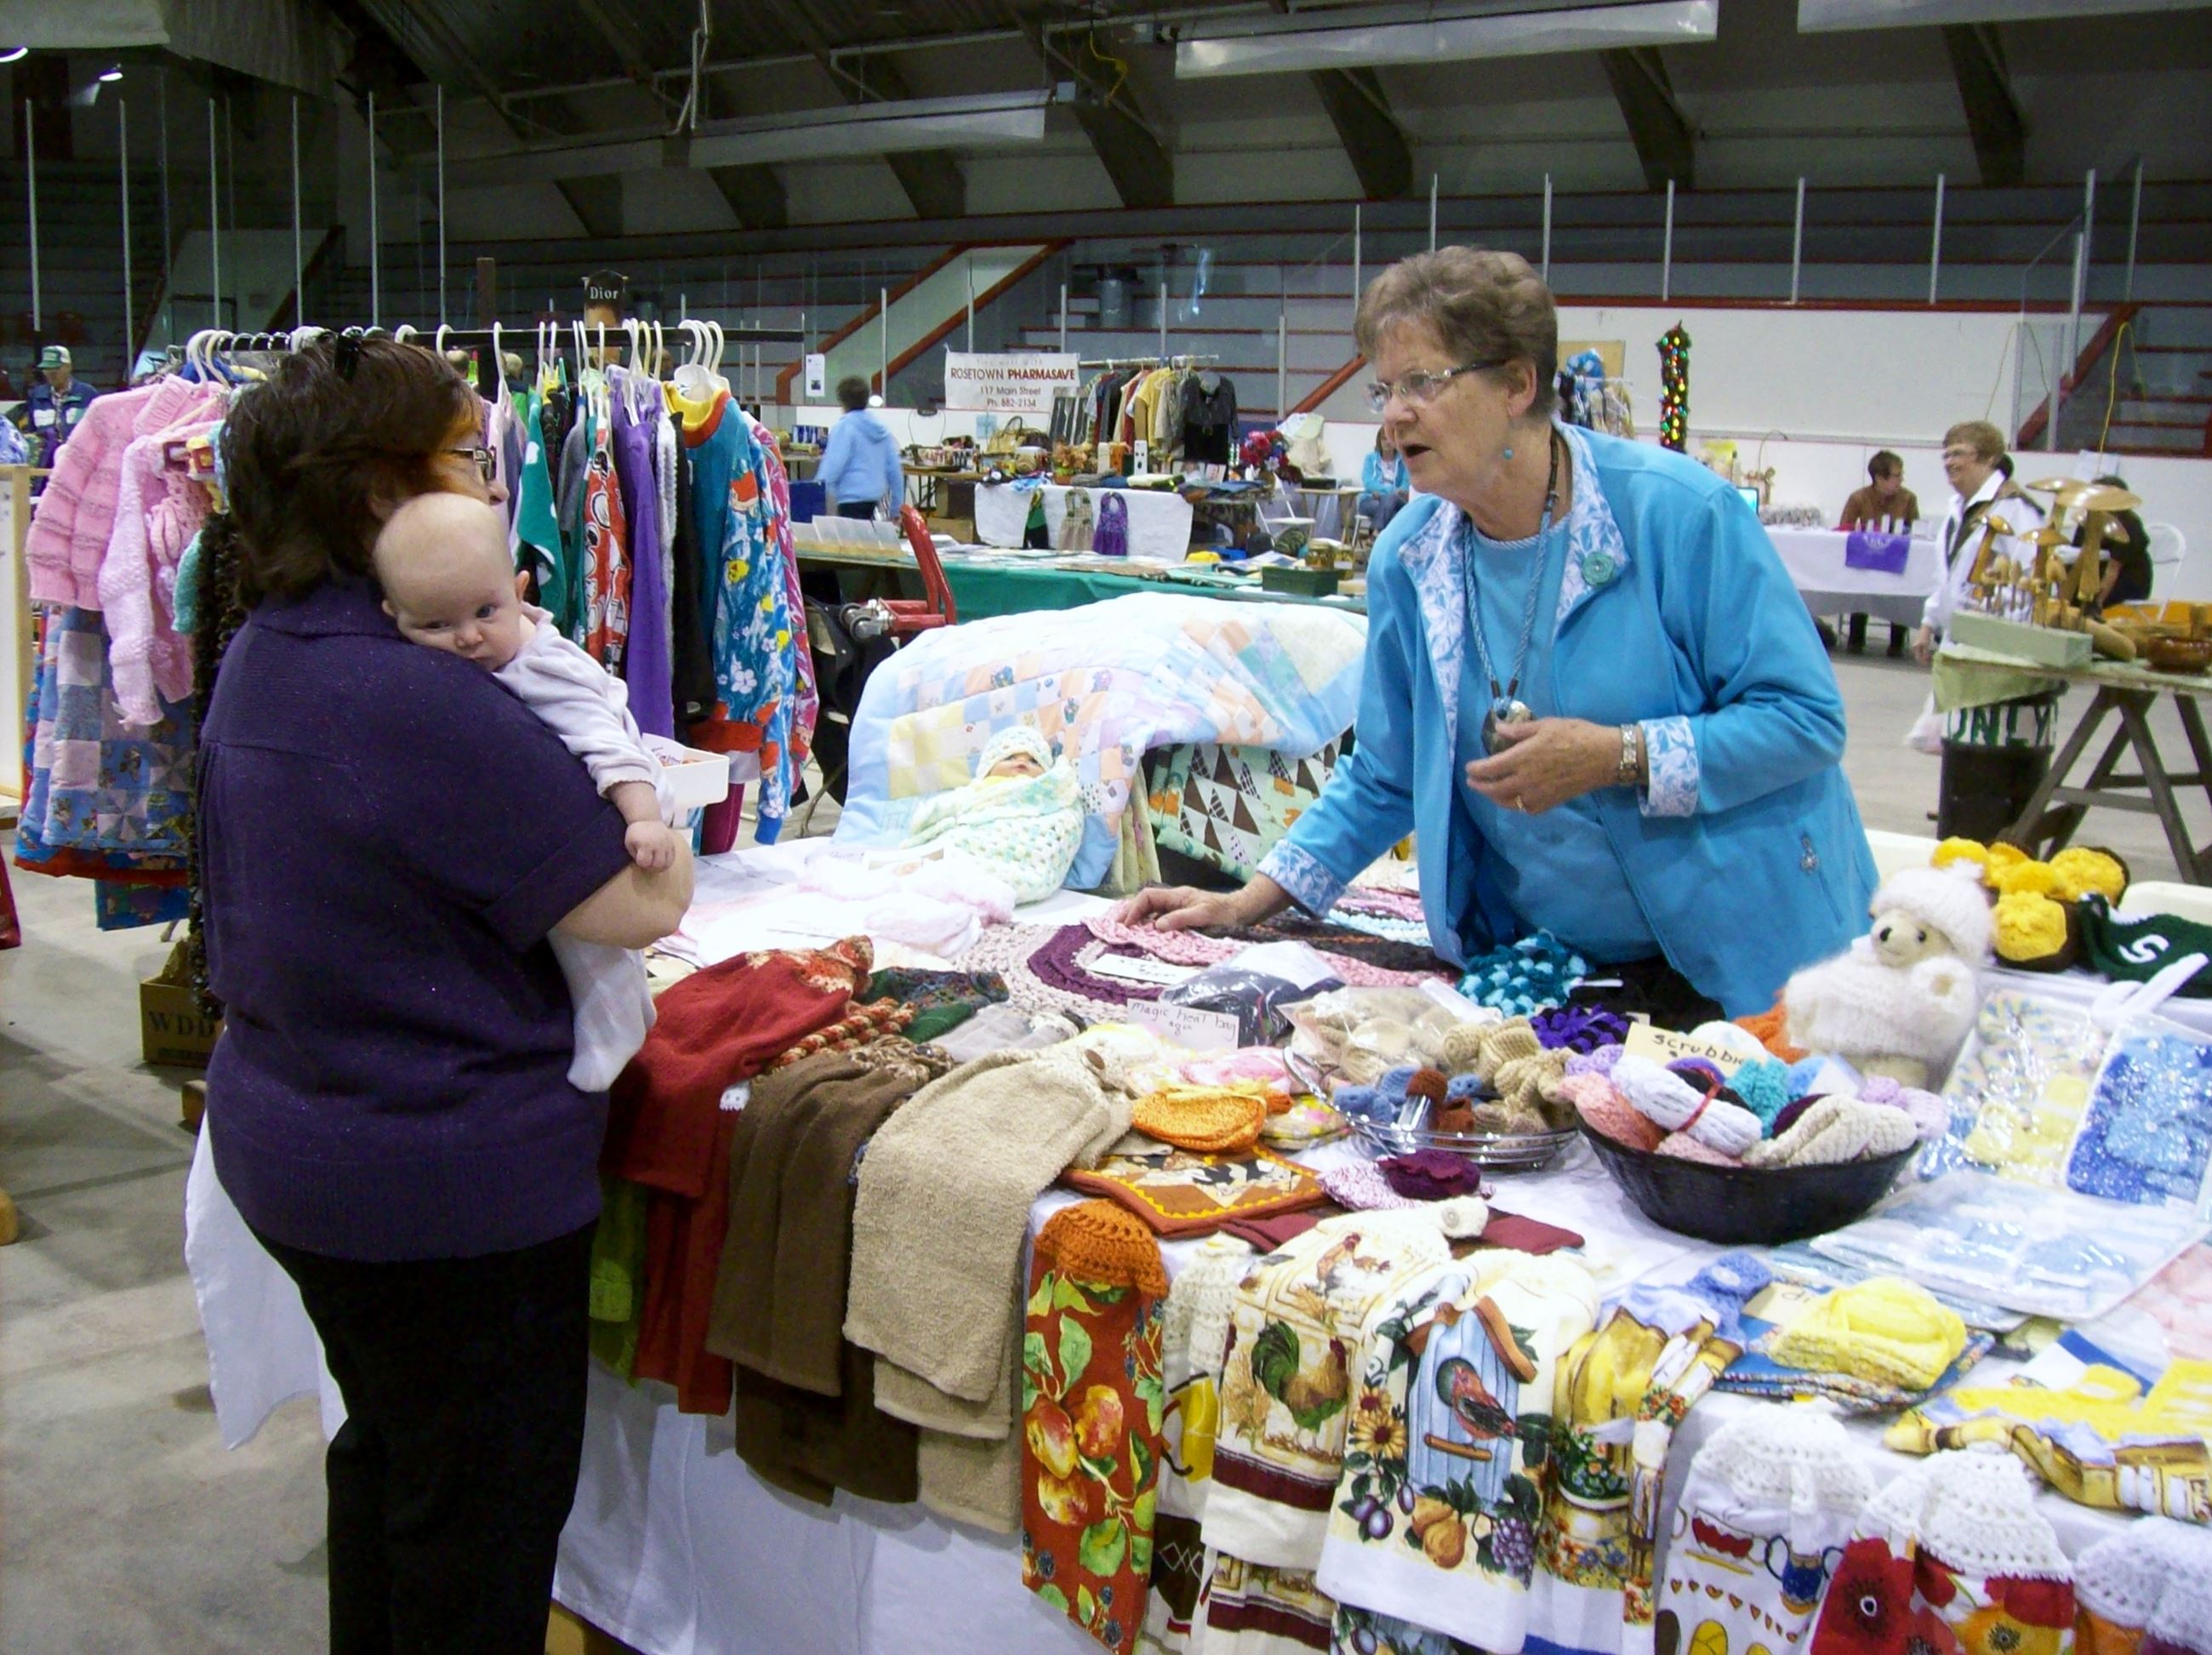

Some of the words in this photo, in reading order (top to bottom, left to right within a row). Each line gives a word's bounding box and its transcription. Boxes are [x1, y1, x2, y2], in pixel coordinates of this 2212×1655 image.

[590, 286, 619, 300] Dior
[950, 368, 1004, 380] ROSETOWN
[1007, 368, 1075, 380] PHARMASAVE
[980, 386, 994, 395] 117
[997, 386, 1017, 396] Main
[1019, 386, 1041, 395] Street
